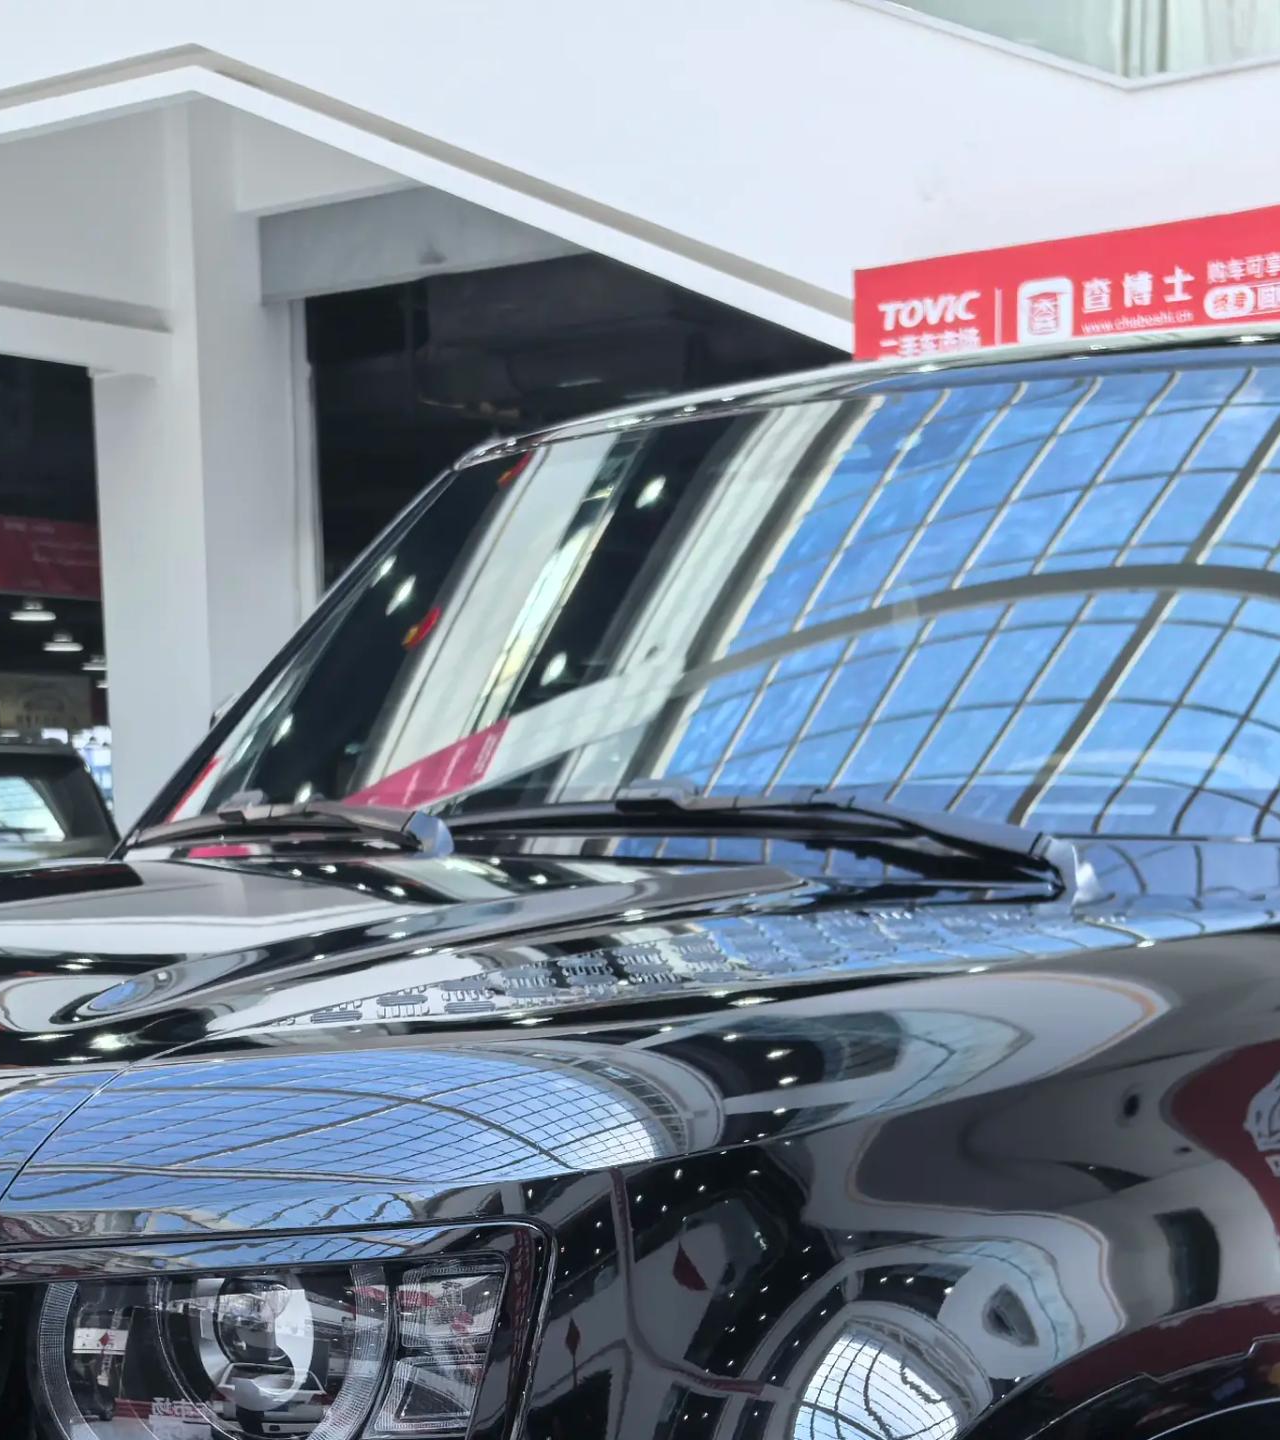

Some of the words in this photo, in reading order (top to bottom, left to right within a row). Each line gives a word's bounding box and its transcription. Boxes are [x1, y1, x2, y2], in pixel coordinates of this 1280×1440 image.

[878, 291, 981, 331] TOVIC
[1082, 265, 1195, 313] 查博士
